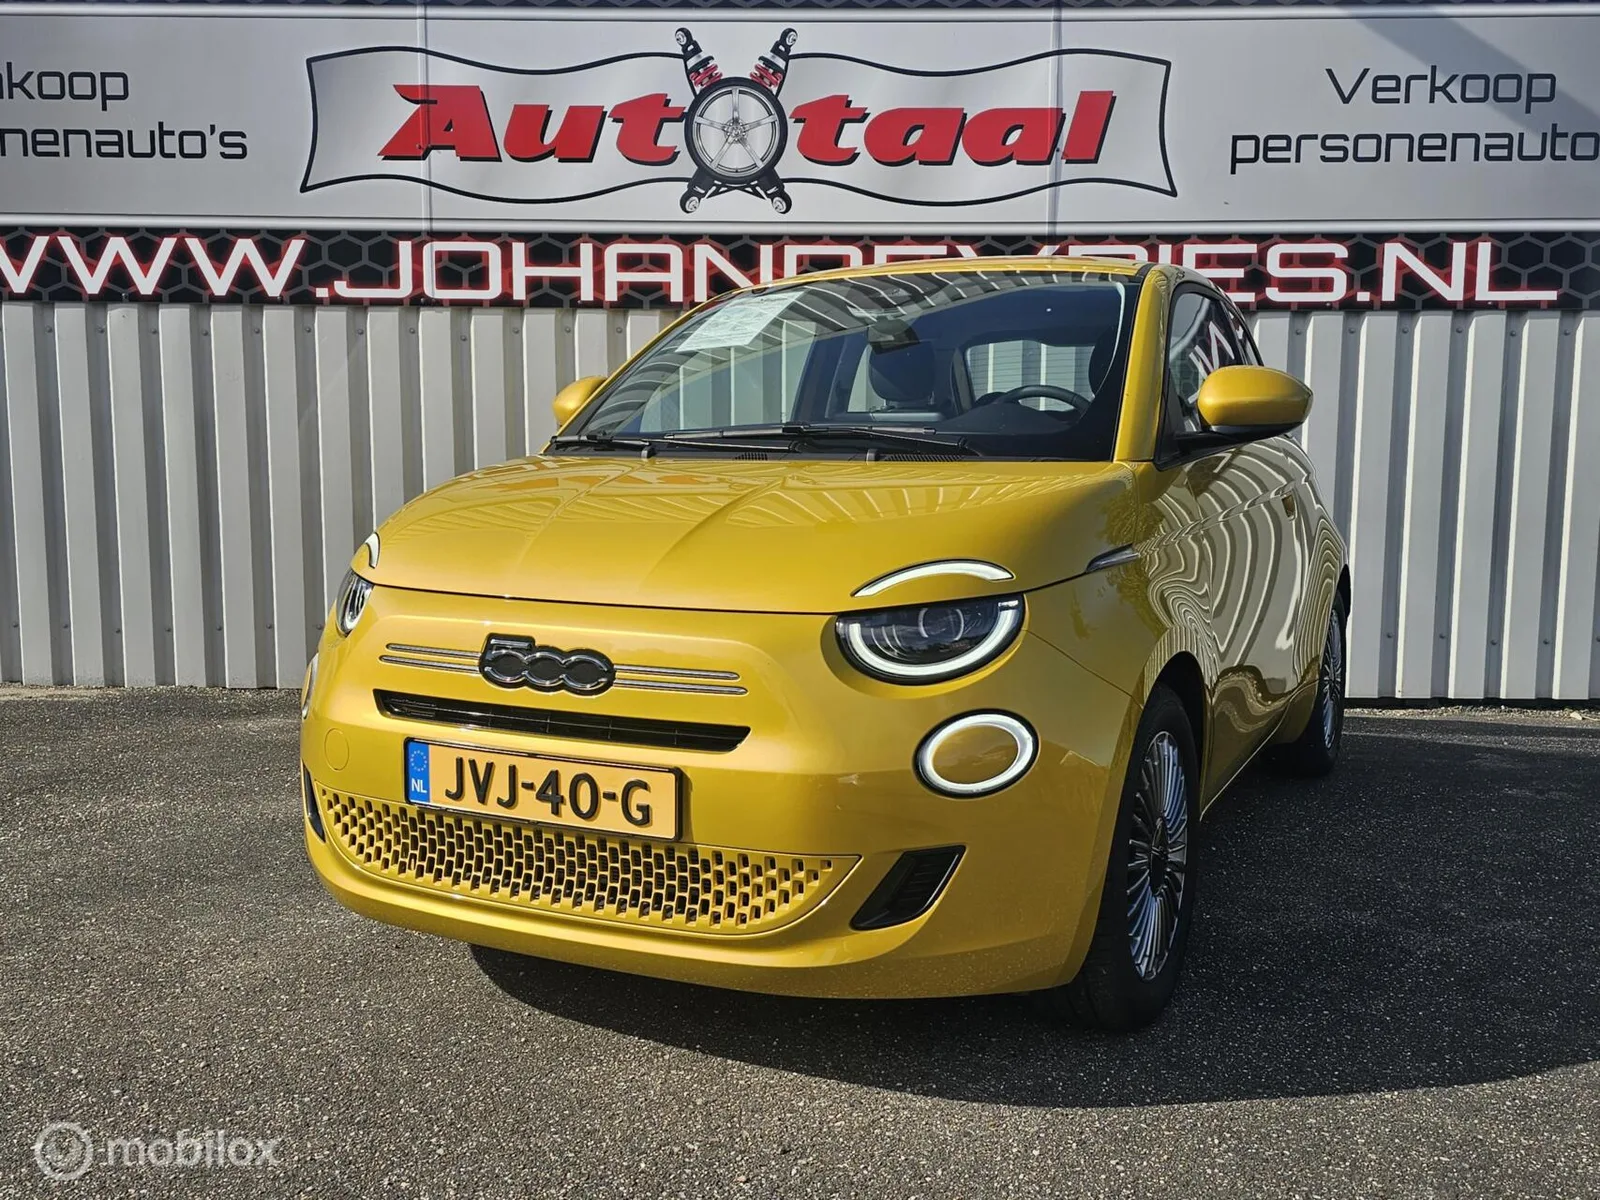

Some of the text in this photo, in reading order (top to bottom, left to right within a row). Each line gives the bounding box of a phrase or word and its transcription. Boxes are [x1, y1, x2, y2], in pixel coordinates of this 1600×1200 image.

[0, 62, 129, 111] koop
[1326, 66, 1556, 113] Verkoop
[1230, 124, 1600, 174] personenauto
[481, 633, 614, 695] 500
[411, 778, 428, 794] NL
[445, 757, 652, 826] JVJ-40-G
